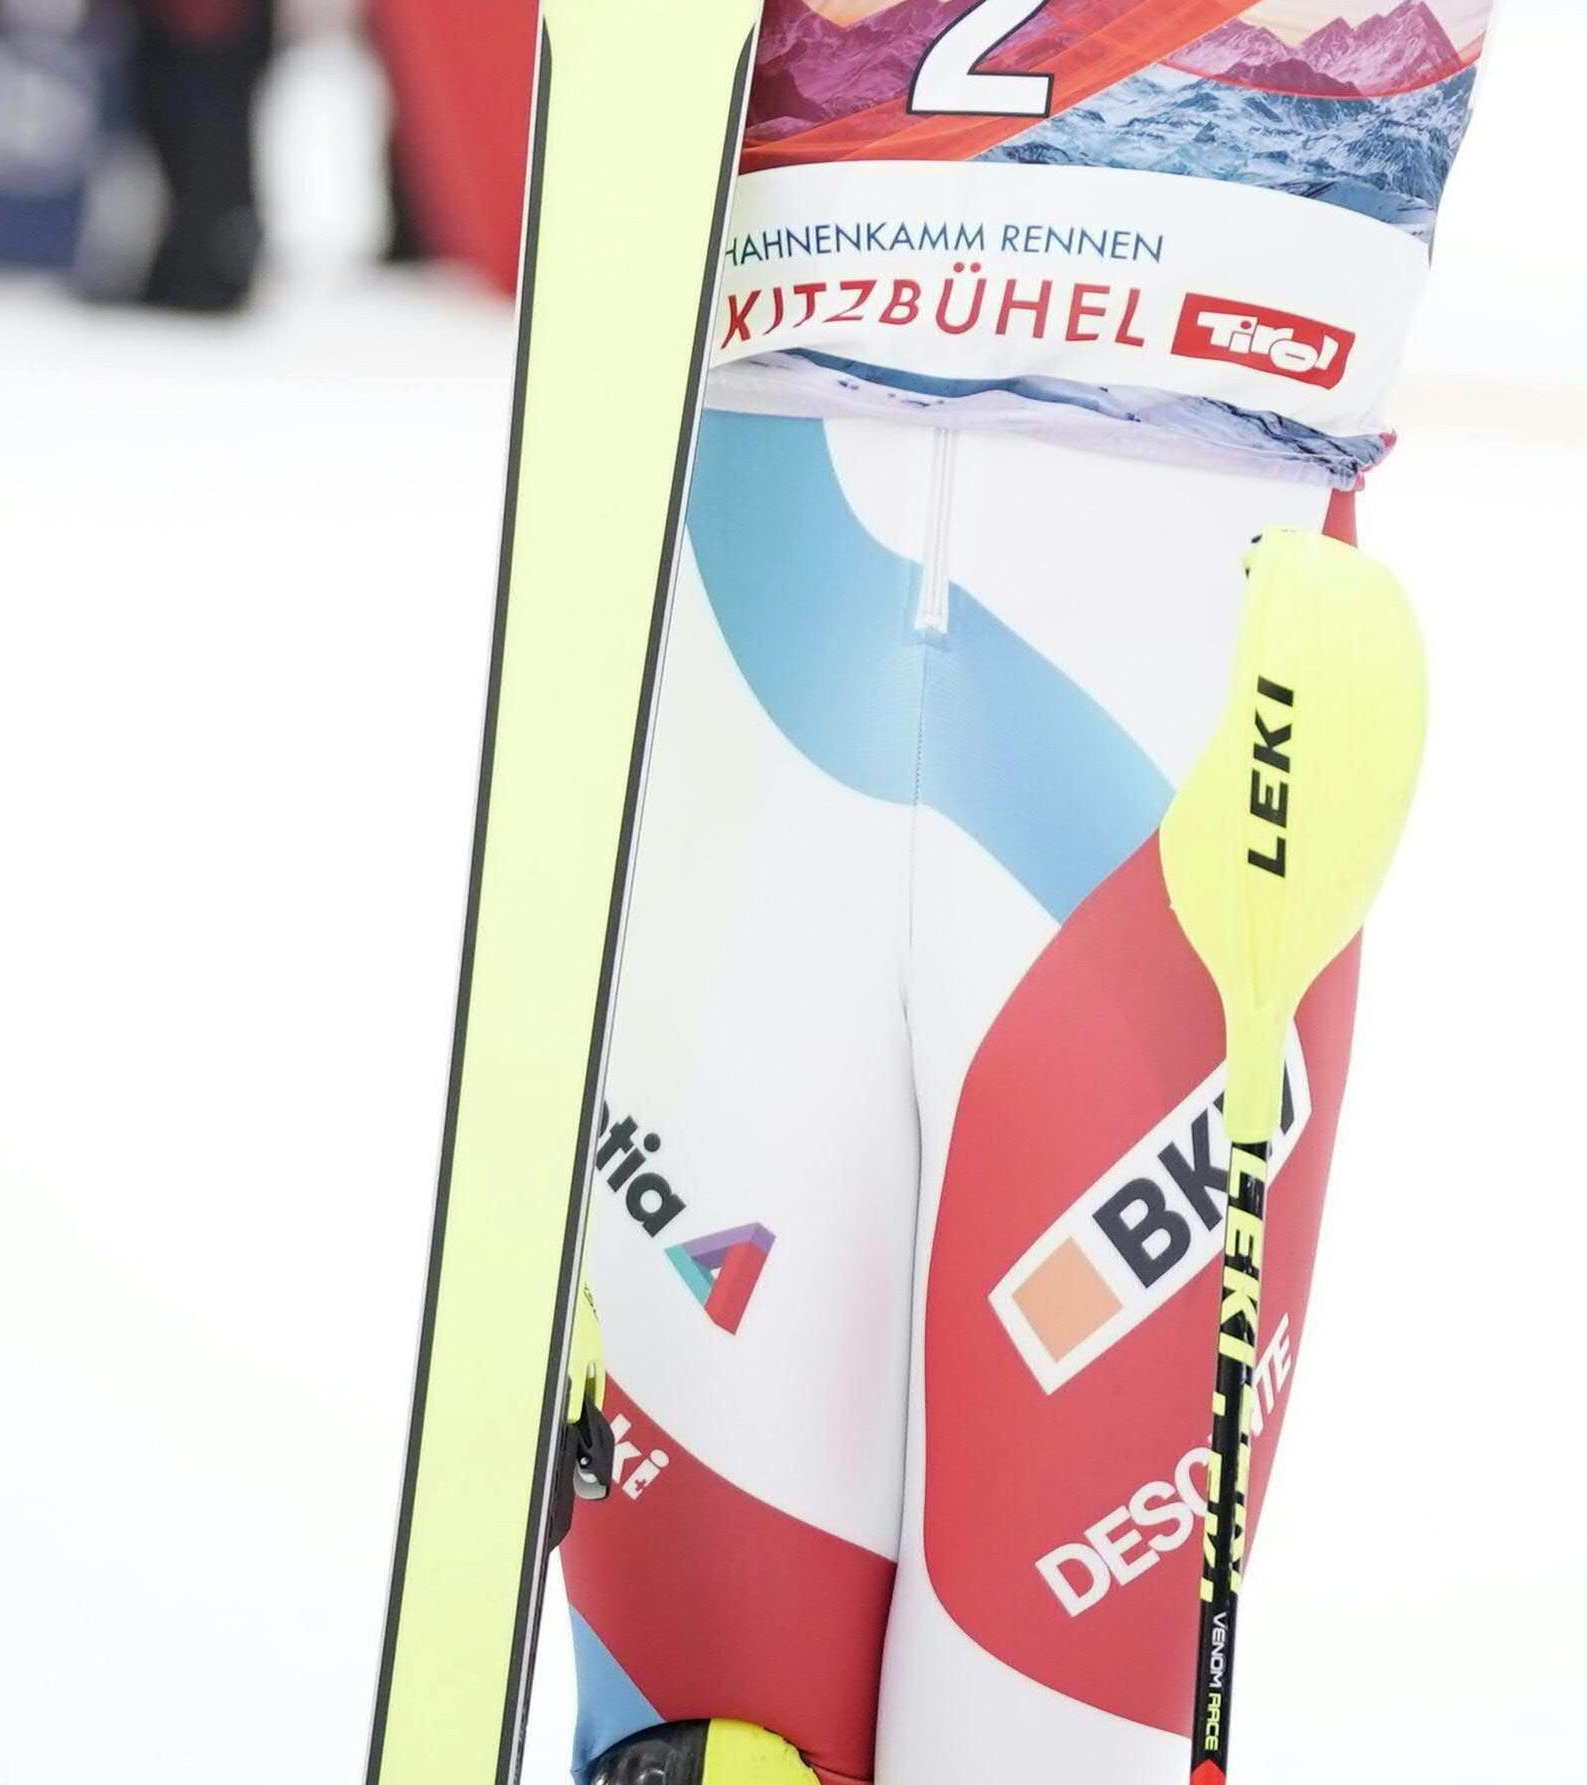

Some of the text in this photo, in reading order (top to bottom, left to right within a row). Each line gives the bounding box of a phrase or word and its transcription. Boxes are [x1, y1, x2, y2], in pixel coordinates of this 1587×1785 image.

[721, 261, 1146, 350] KITZBÜHEL
[725, 220, 1164, 267] HAHNENKAMM RENNEN
[1196, 312, 1333, 373] Tirol
[1247, 674, 1296, 880] LEKI
[1218, 1147, 1269, 1368] LEKI
[1034, 1311, 1292, 1618] DESCTE
[1204, 1611, 1228, 1753] VENOM RACE
